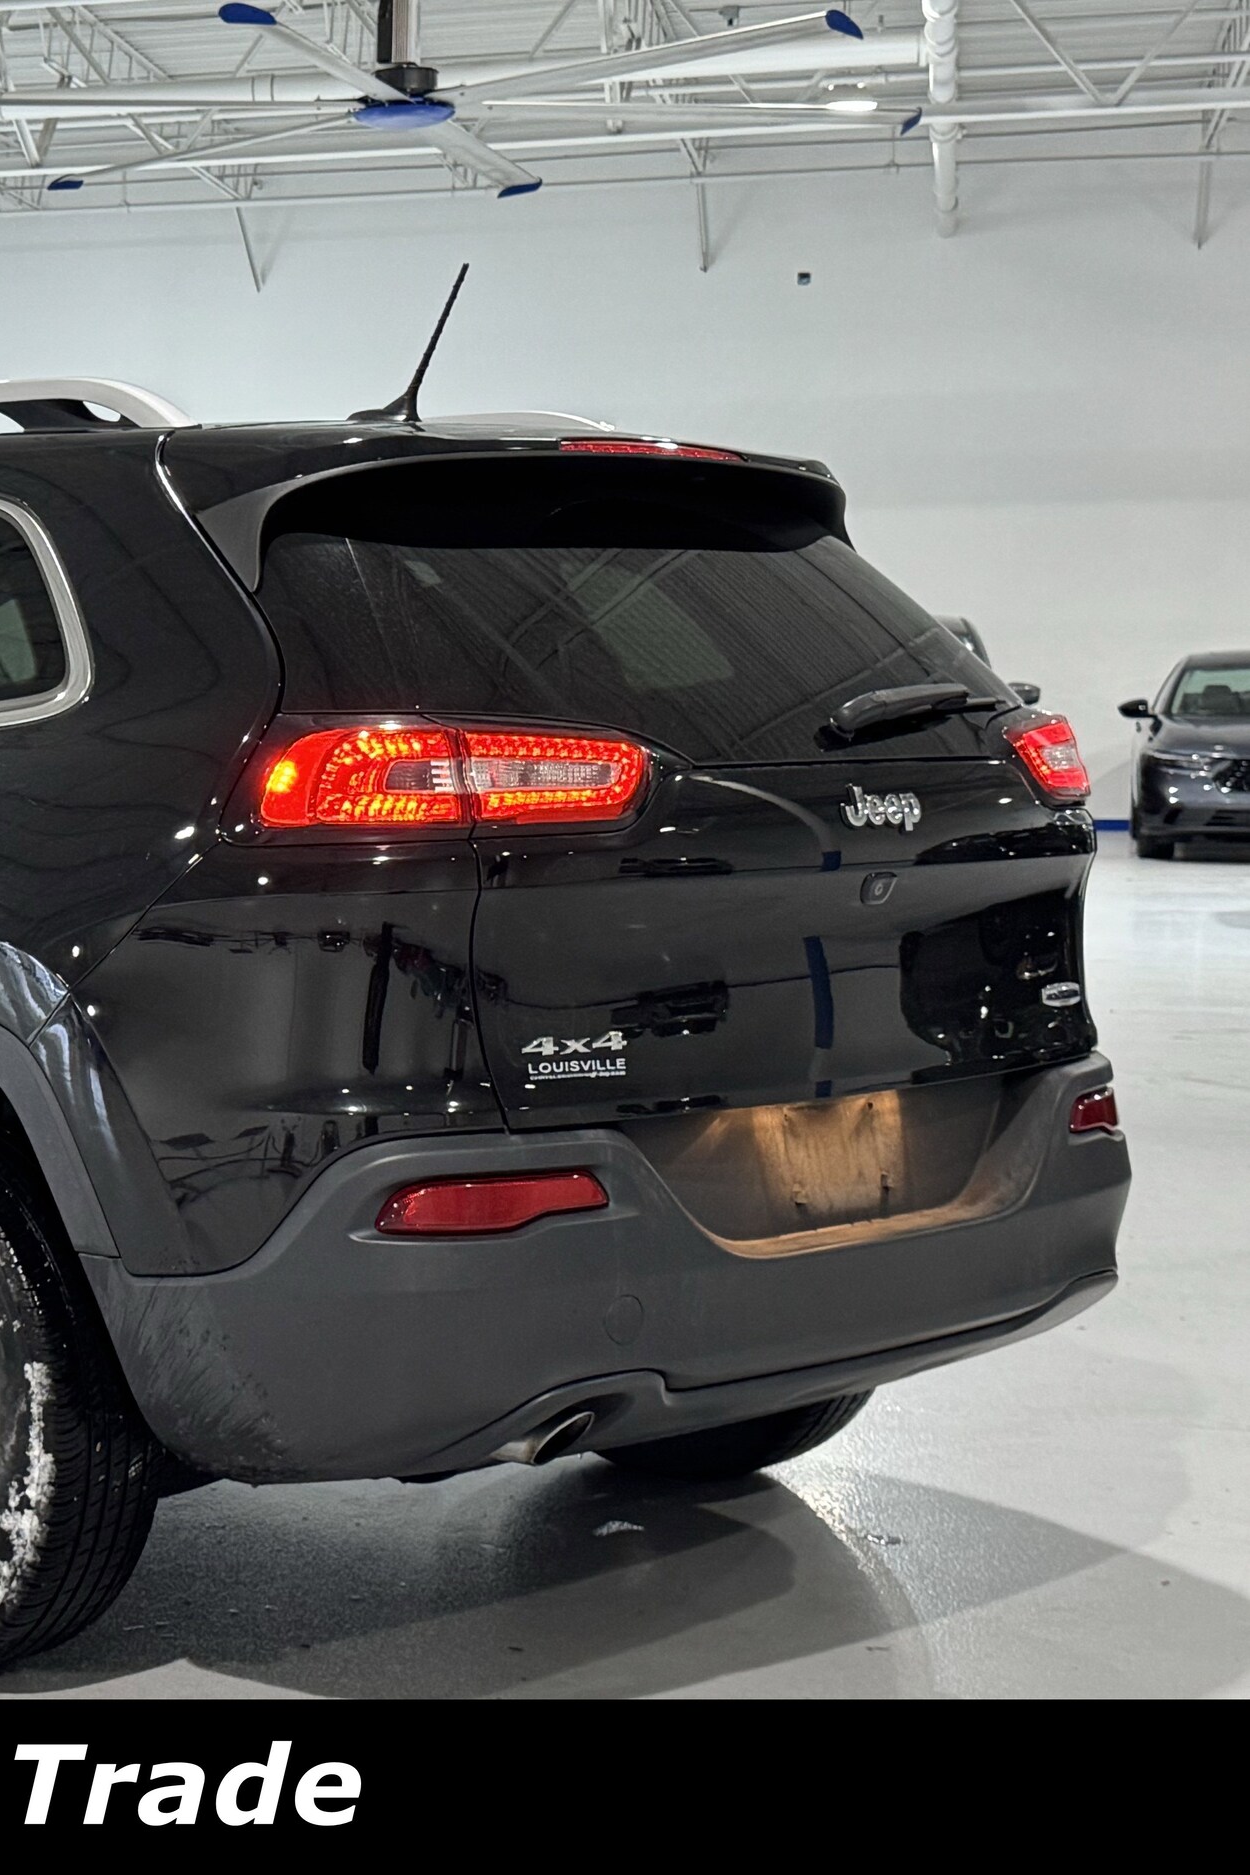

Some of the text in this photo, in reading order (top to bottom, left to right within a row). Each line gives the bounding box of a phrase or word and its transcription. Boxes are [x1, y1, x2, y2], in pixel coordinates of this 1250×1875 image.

[840, 783, 922, 832] Jeep
[521, 1030, 628, 1056] 4x4
[527, 1058, 627, 1075] LOUISVILLE
